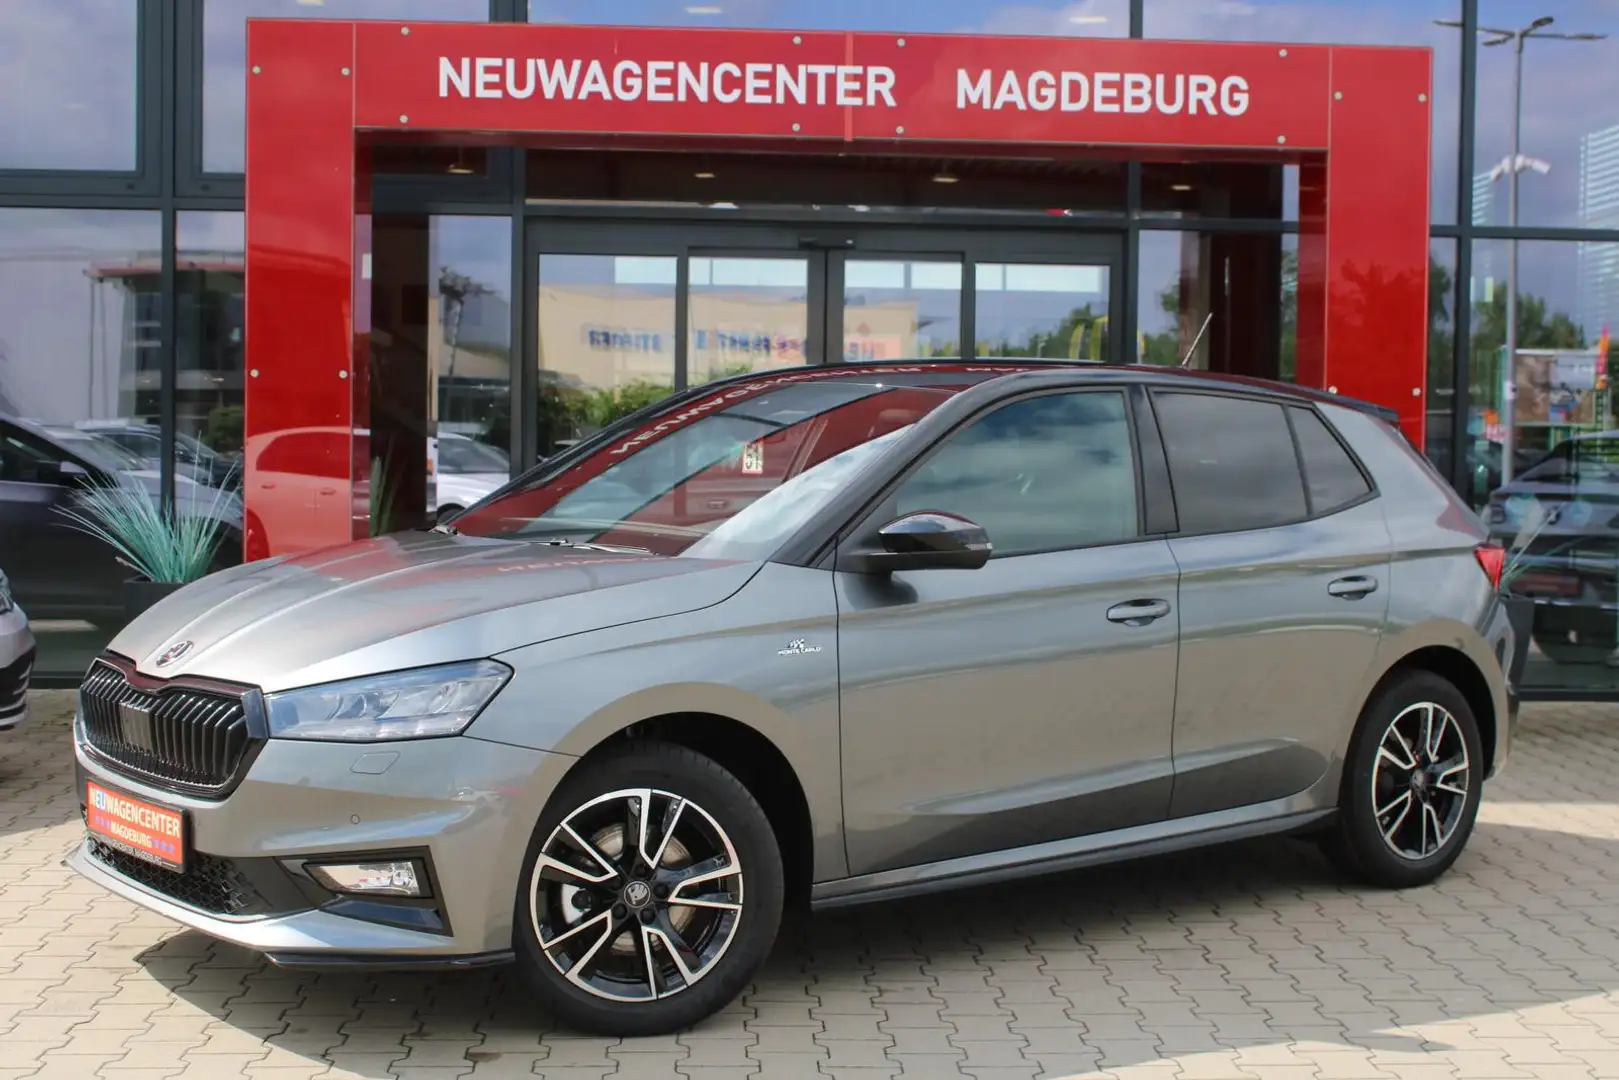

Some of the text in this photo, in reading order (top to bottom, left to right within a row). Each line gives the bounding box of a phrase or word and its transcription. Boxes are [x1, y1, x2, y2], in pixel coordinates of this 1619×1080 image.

[438, 56, 1250, 117] NEUWAGENCENTER MAGDEBURG
[88, 787, 181, 839] NEUWAGENCENTER
[110, 821, 153, 848] MAGDEBURG
